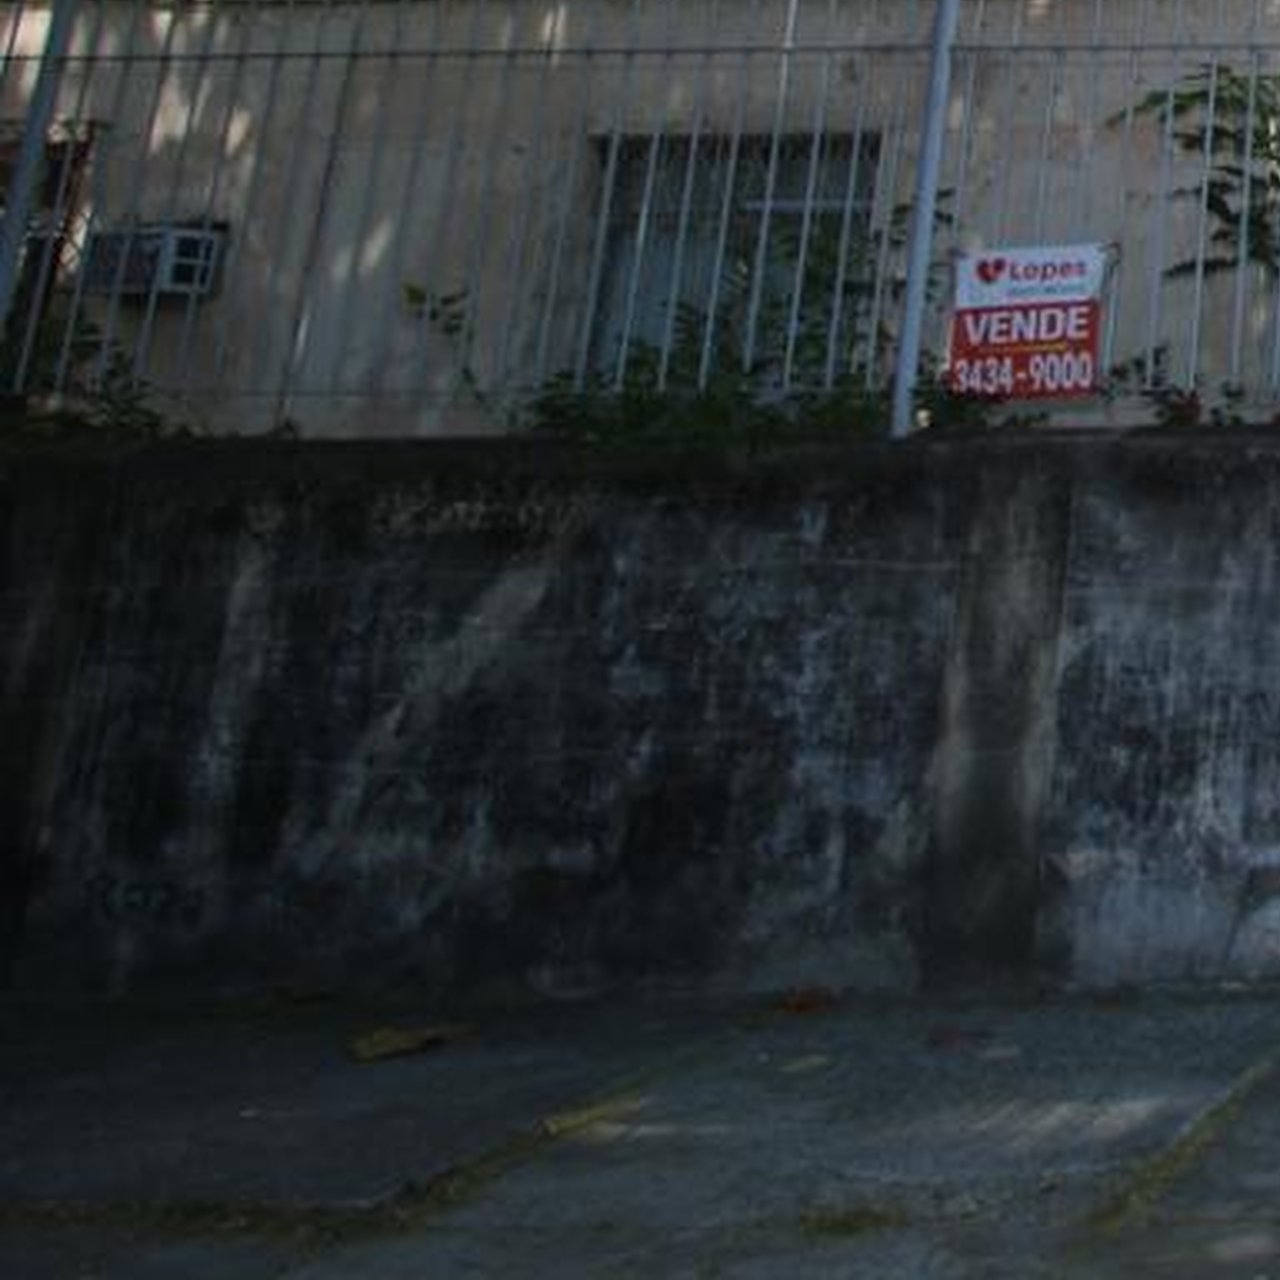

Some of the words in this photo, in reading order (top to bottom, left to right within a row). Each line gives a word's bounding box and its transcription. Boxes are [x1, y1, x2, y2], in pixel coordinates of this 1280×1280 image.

[1010, 261, 1087, 283] Lopes
[964, 305, 1090, 347] VENDE
[955, 350, 1093, 396] 3434-9000
